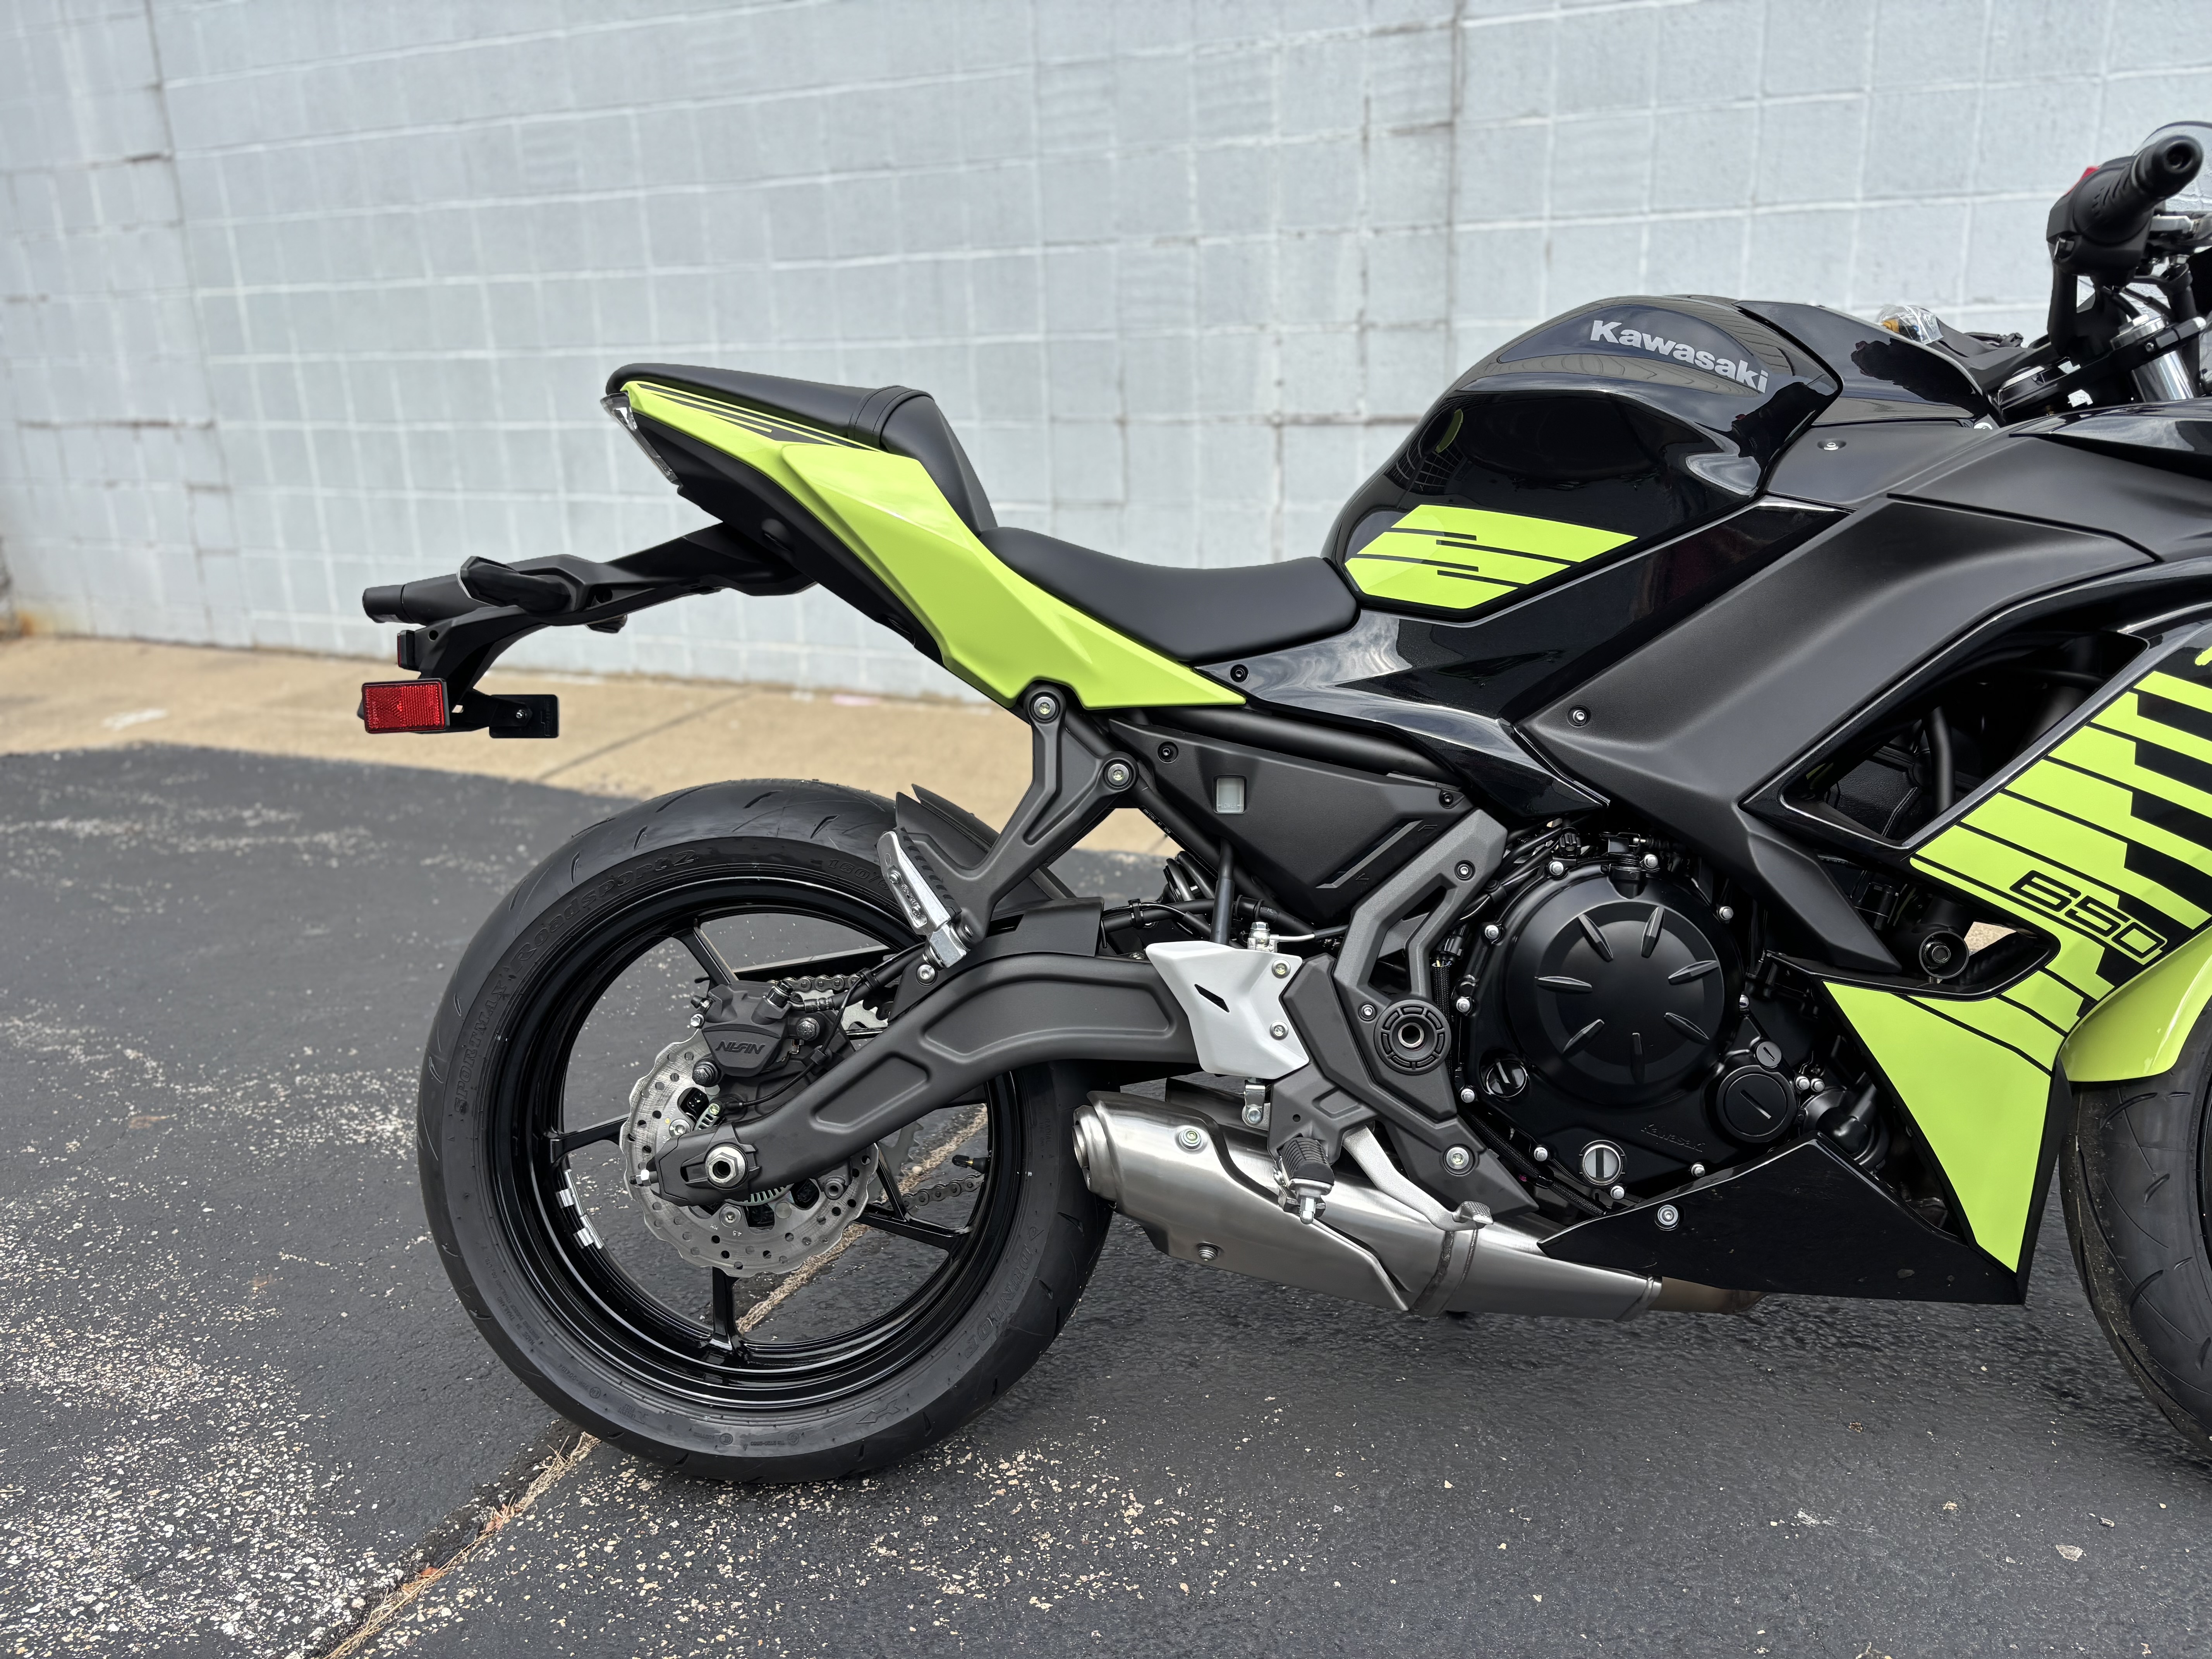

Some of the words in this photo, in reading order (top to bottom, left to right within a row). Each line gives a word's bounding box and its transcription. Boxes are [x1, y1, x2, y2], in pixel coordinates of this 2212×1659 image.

[1590, 320, 1769, 393] Kawasaki
[2009, 870, 2166, 958] 650
[454, 979, 508, 1115] SPORTMAX
[716, 1041, 765, 1054] NISSIN
[497, 1296, 515, 1321] THAILAND
[964, 1243, 1035, 1359] DUNLOP
[522, 1331, 535, 1345] MADE
